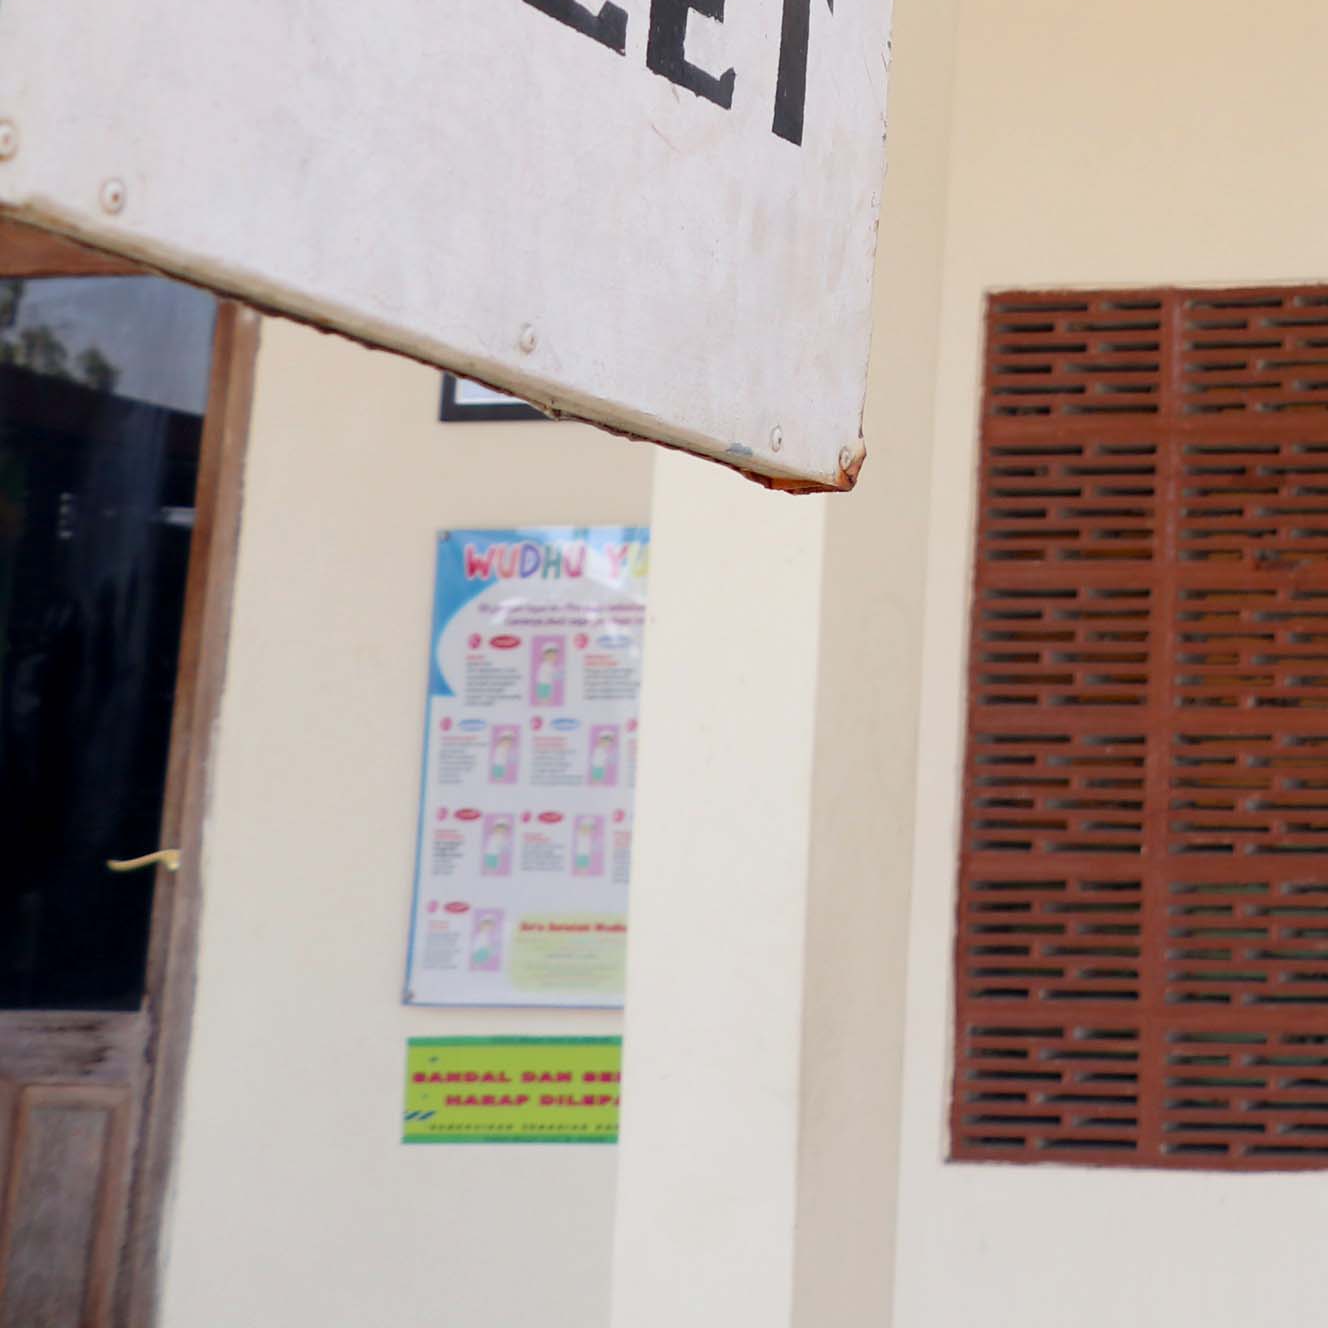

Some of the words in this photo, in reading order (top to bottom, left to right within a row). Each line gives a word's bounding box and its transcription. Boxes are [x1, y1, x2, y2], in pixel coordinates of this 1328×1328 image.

[464, 543, 587, 580] WUDHU
[412, 1071, 512, 1084] SANDAL
[521, 1071, 572, 1084] DAN
[445, 1094, 530, 1107] HARAP
